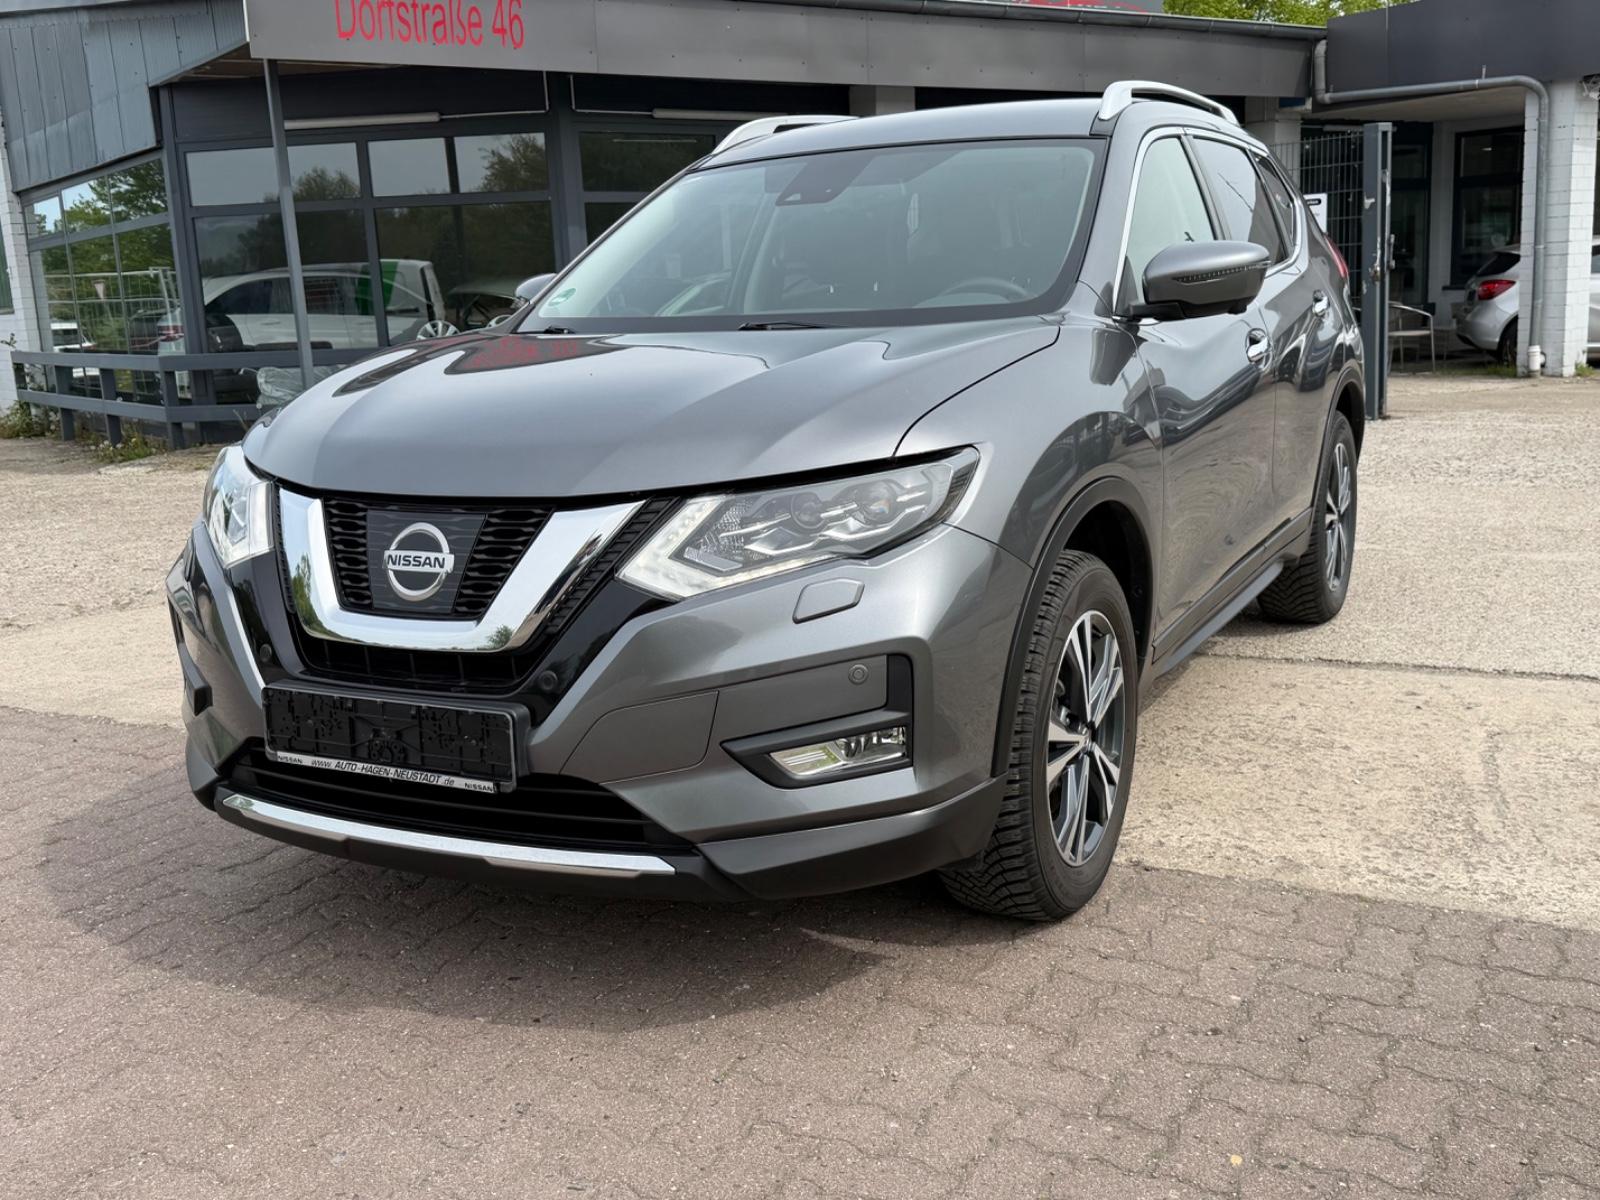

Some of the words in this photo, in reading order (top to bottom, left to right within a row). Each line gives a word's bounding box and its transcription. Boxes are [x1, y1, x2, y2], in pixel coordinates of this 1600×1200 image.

[492, 0, 524, 48] 46
[387, 554, 446, 568] NISSAN
[278, 755, 303, 764] NISSAN
[464, 782, 493, 792] NISSAN
